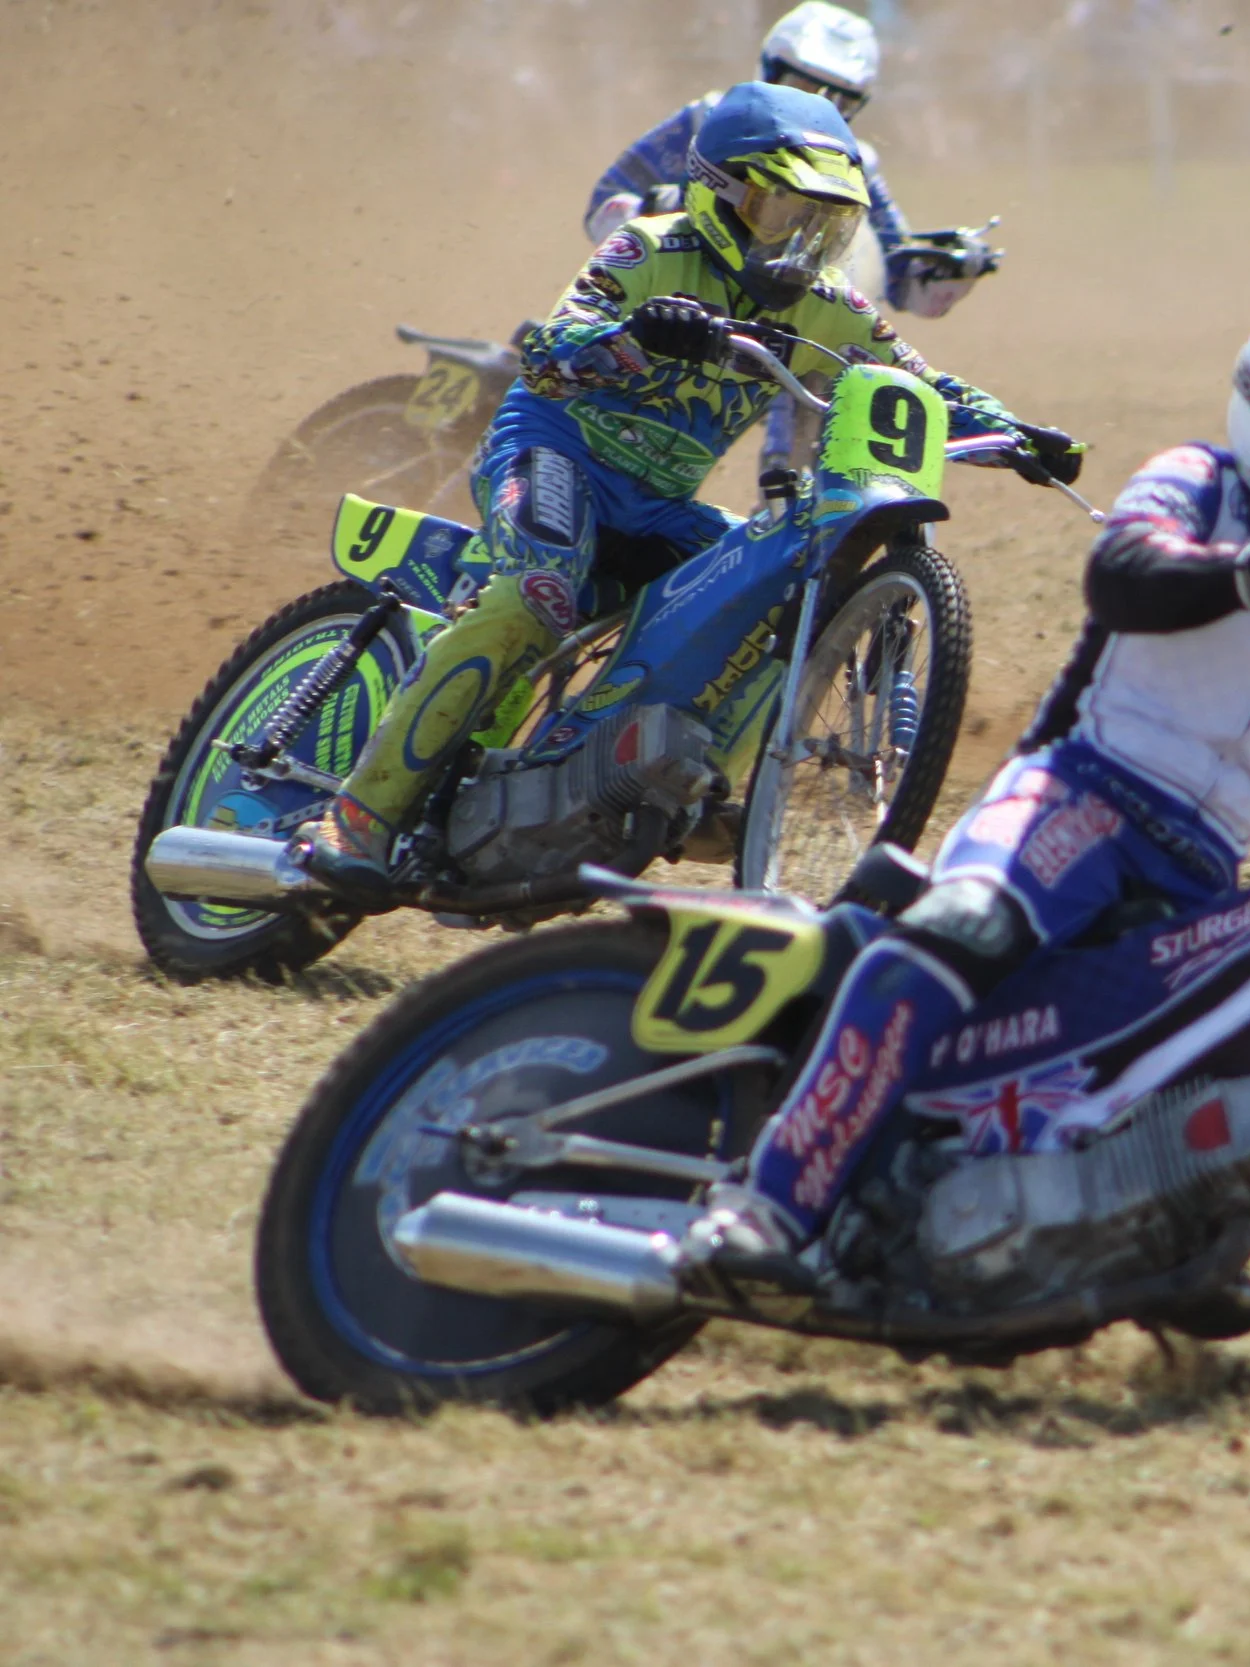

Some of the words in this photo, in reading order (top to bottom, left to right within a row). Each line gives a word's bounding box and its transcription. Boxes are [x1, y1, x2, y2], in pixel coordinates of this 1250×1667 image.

[413, 369, 472, 413] 24
[868, 385, 927, 473] 9
[349, 506, 396, 562] 9
[249, 675, 290, 719] METALS
[649, 921, 796, 1032] 15
[957, 1005, 1060, 1065] O'HARA
[777, 1025, 870, 1157] MSC
